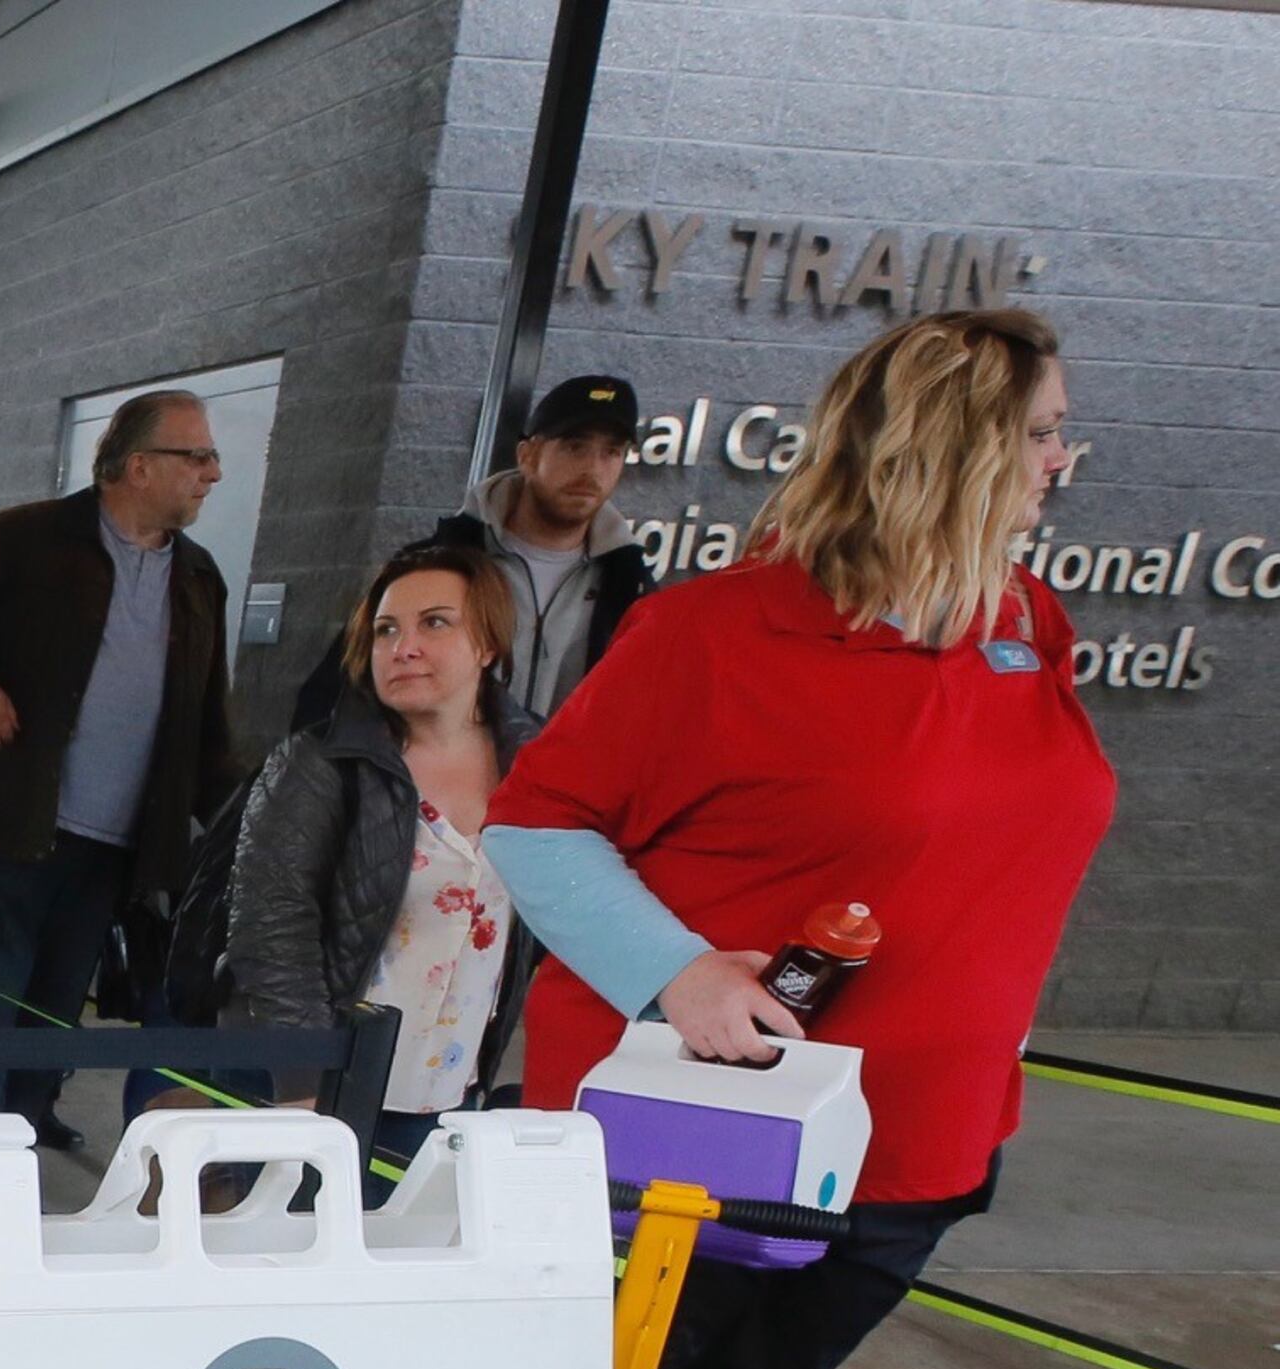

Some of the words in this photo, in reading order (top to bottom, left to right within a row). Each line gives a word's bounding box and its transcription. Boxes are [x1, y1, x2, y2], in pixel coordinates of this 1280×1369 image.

[545, 200, 704, 294] KY
[725, 405, 808, 473] Ca
[1008, 526, 1201, 595] tional
[1211, 536, 1280, 599] Co
[1071, 626, 1218, 690] otels
